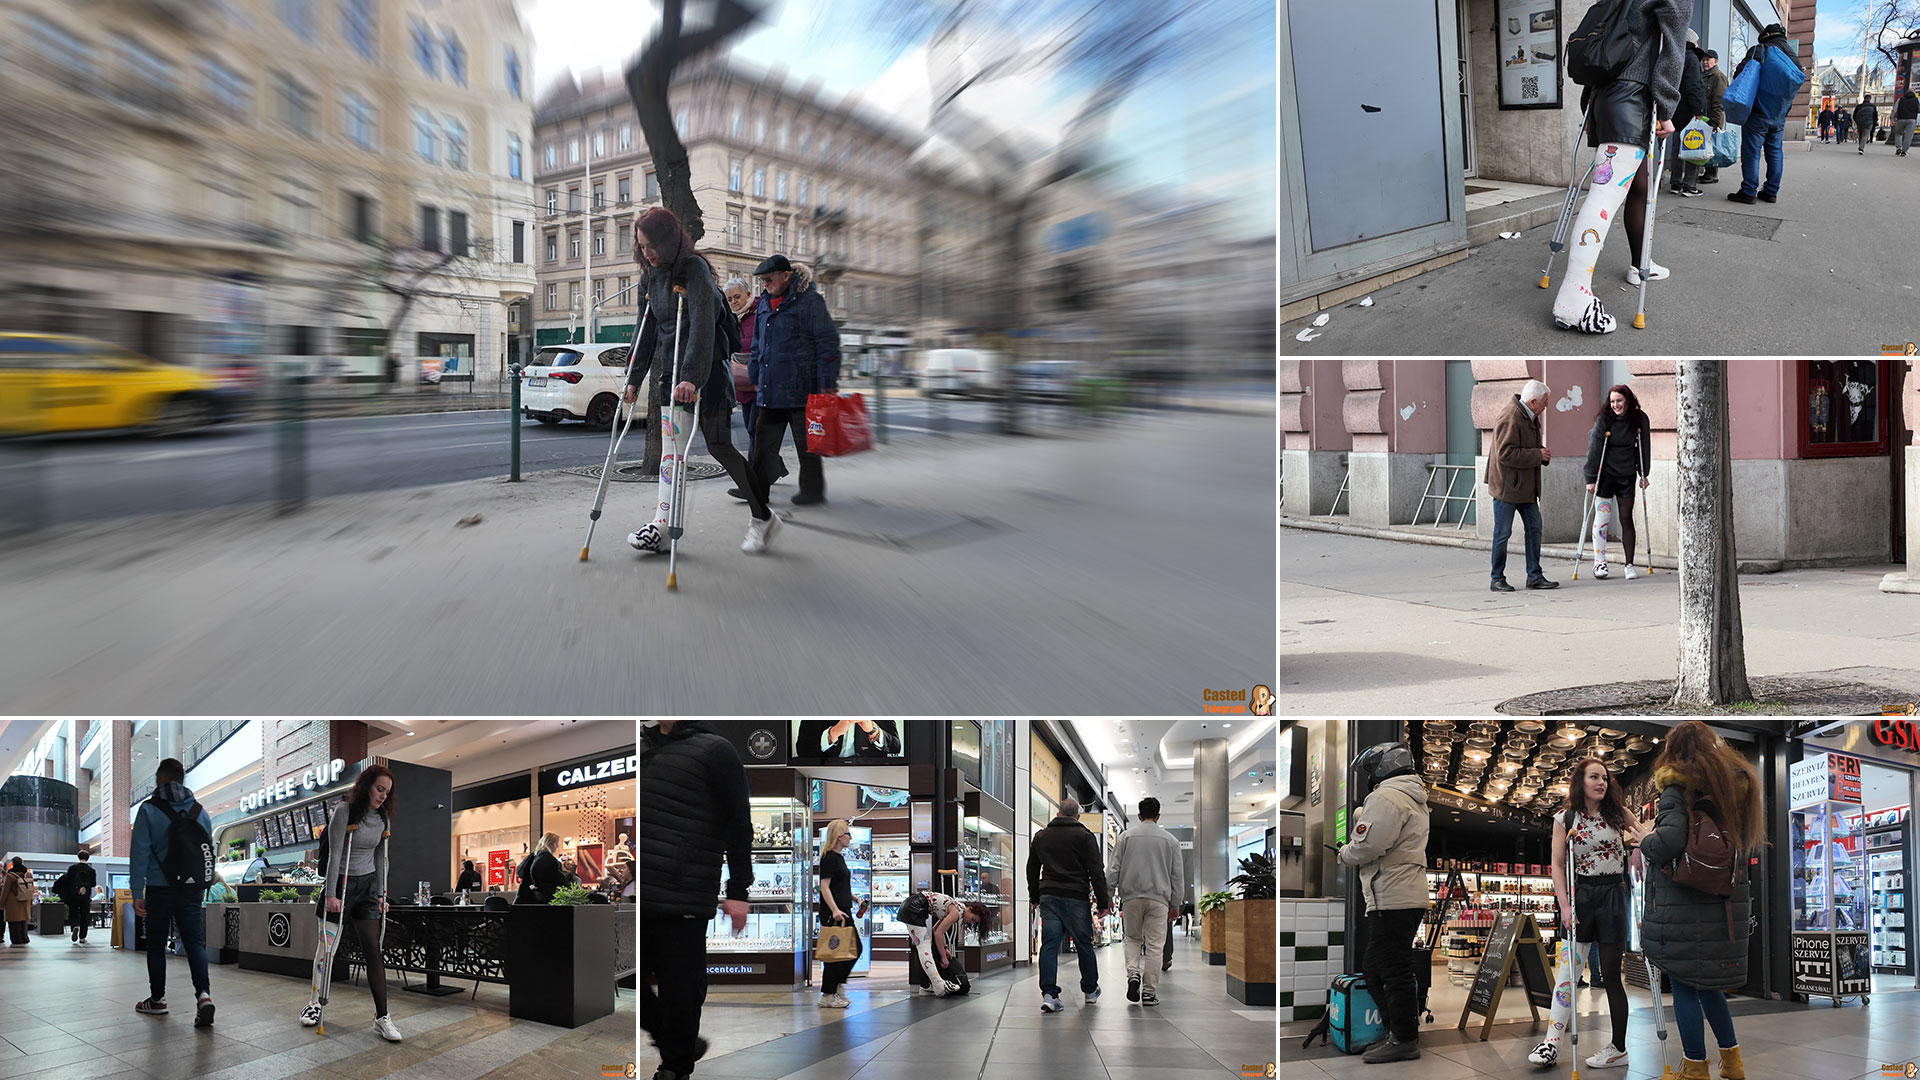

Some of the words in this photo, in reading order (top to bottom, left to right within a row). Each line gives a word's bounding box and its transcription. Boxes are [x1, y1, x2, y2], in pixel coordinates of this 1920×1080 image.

[557, 755, 636, 787] CALZED
[1791, 761, 1826, 778] SZERVIZ
[240, 777, 298, 813] COFFEE
[303, 758, 345, 791] CUP
[1792, 774, 1826, 790] HELYBEN
[1792, 786, 1827, 802] SZERVIZ
[201, 843, 213, 882] adidas
[1794, 937, 1830, 949] iPhone
[1836, 936, 1867, 945] SZERVIZ
[1794, 950, 1830, 959] SZERVIZ
[1795, 960, 1831, 975] ITT!
[1839, 978, 1870, 993] ITT!
